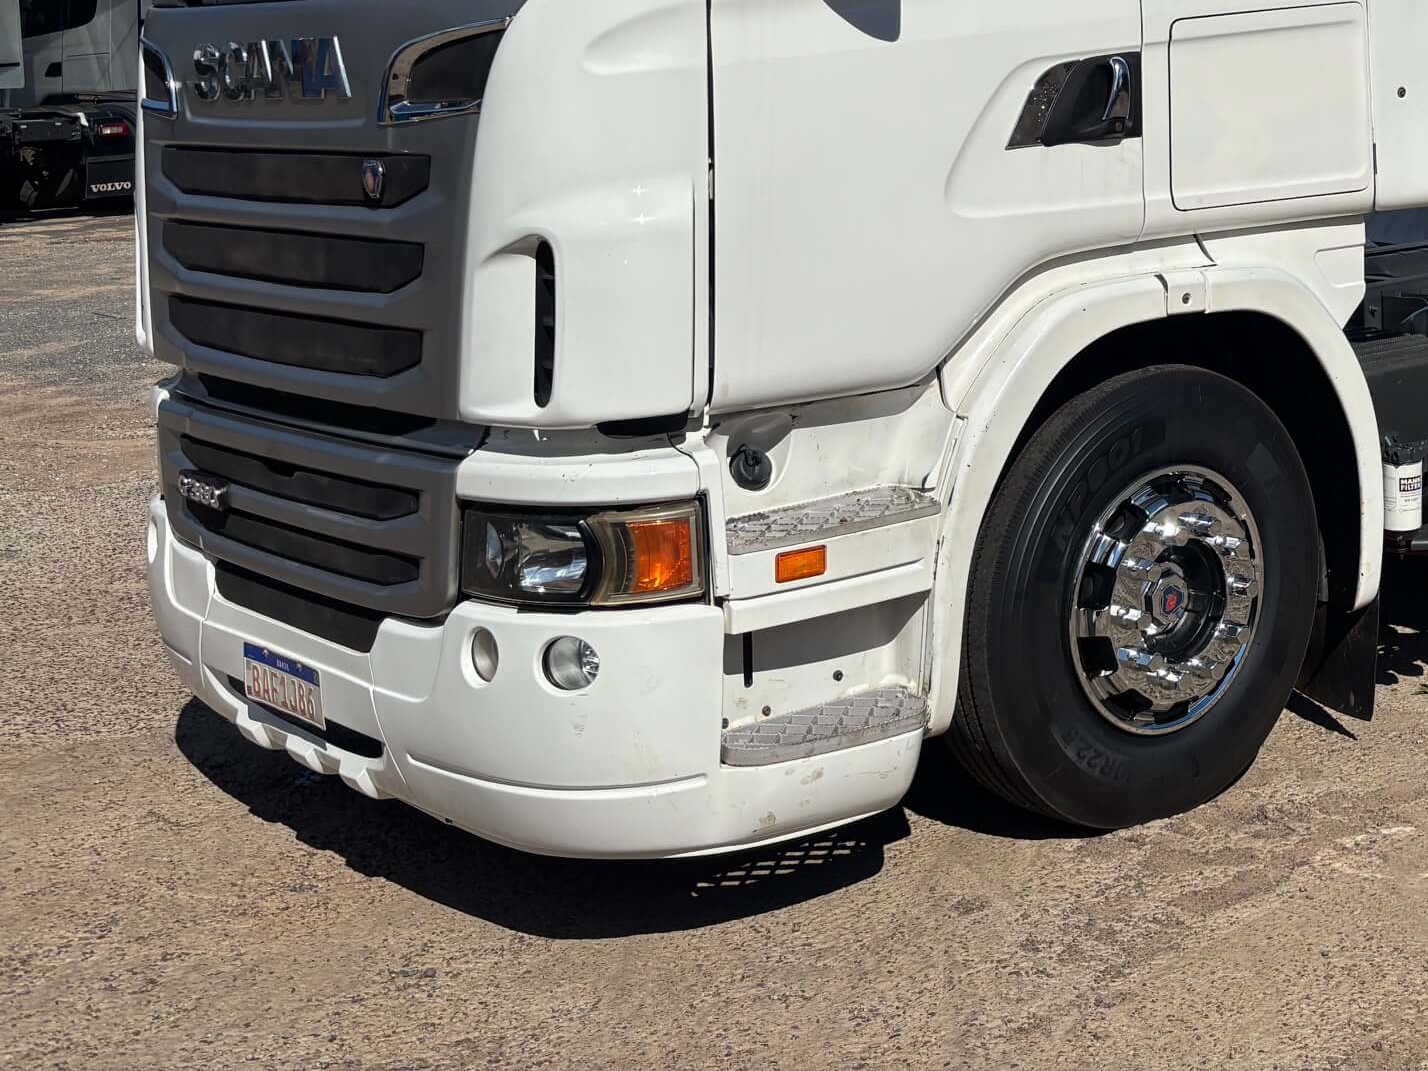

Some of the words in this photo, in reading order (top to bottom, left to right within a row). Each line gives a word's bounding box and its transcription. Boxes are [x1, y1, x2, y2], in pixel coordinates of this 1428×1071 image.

[192, 35, 352, 102] SCANIA
[90, 181, 132, 193] VOLVO
[1401, 476, 1421, 485] MANN
